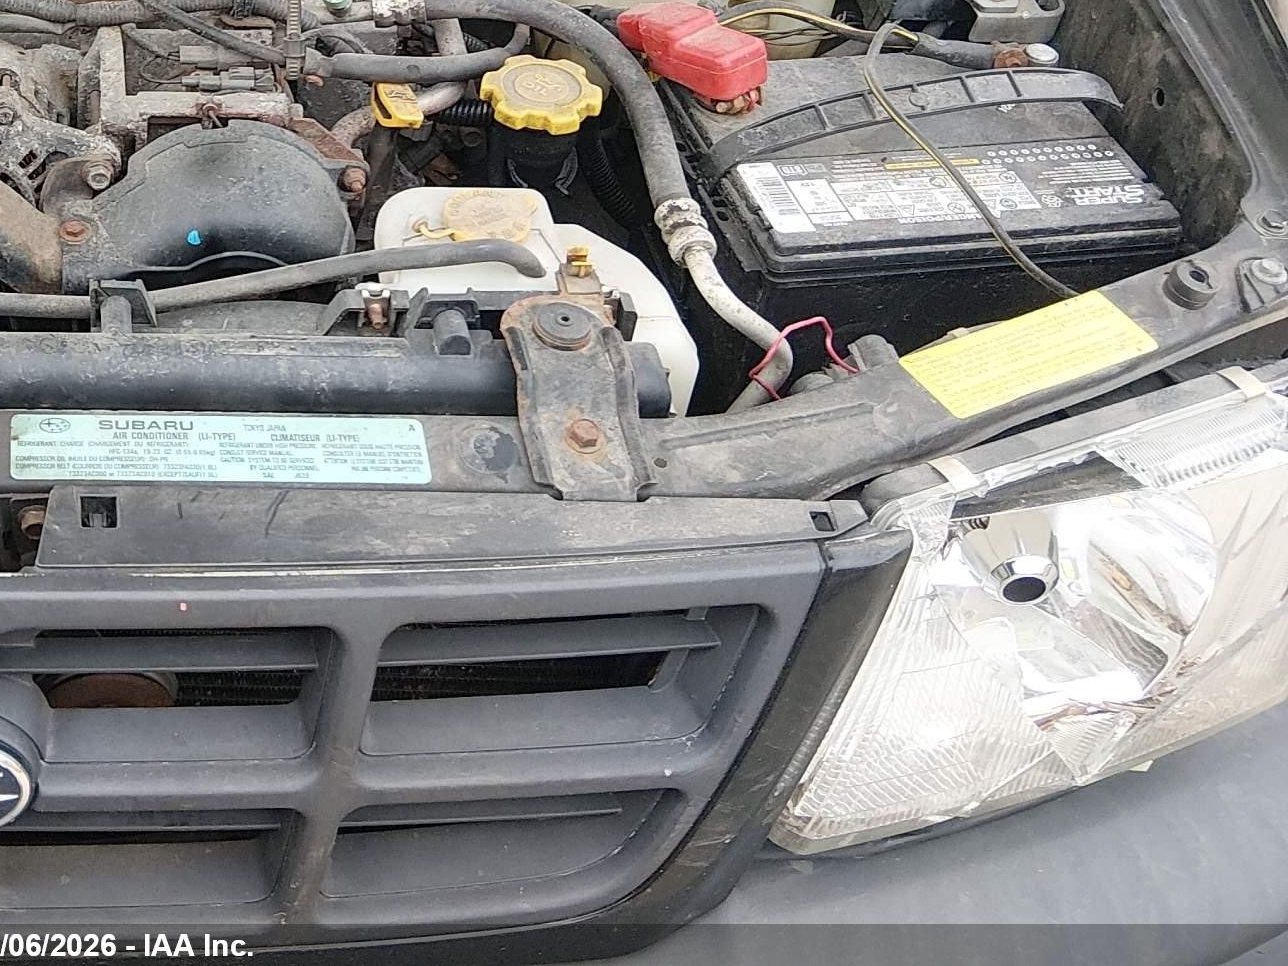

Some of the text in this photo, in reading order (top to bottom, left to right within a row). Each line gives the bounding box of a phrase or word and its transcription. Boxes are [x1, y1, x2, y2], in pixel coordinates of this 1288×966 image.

[521, 80, 547, 96] OIL
[1072, 185, 1145, 197] START
[1074, 195, 1144, 206] SUPER
[98, 420, 194, 430] SUBARU
[113, 432, 128, 440] AIR
[132, 432, 189, 440] CONDITIONER
[270, 433, 321, 442] CLIMATISEUR
